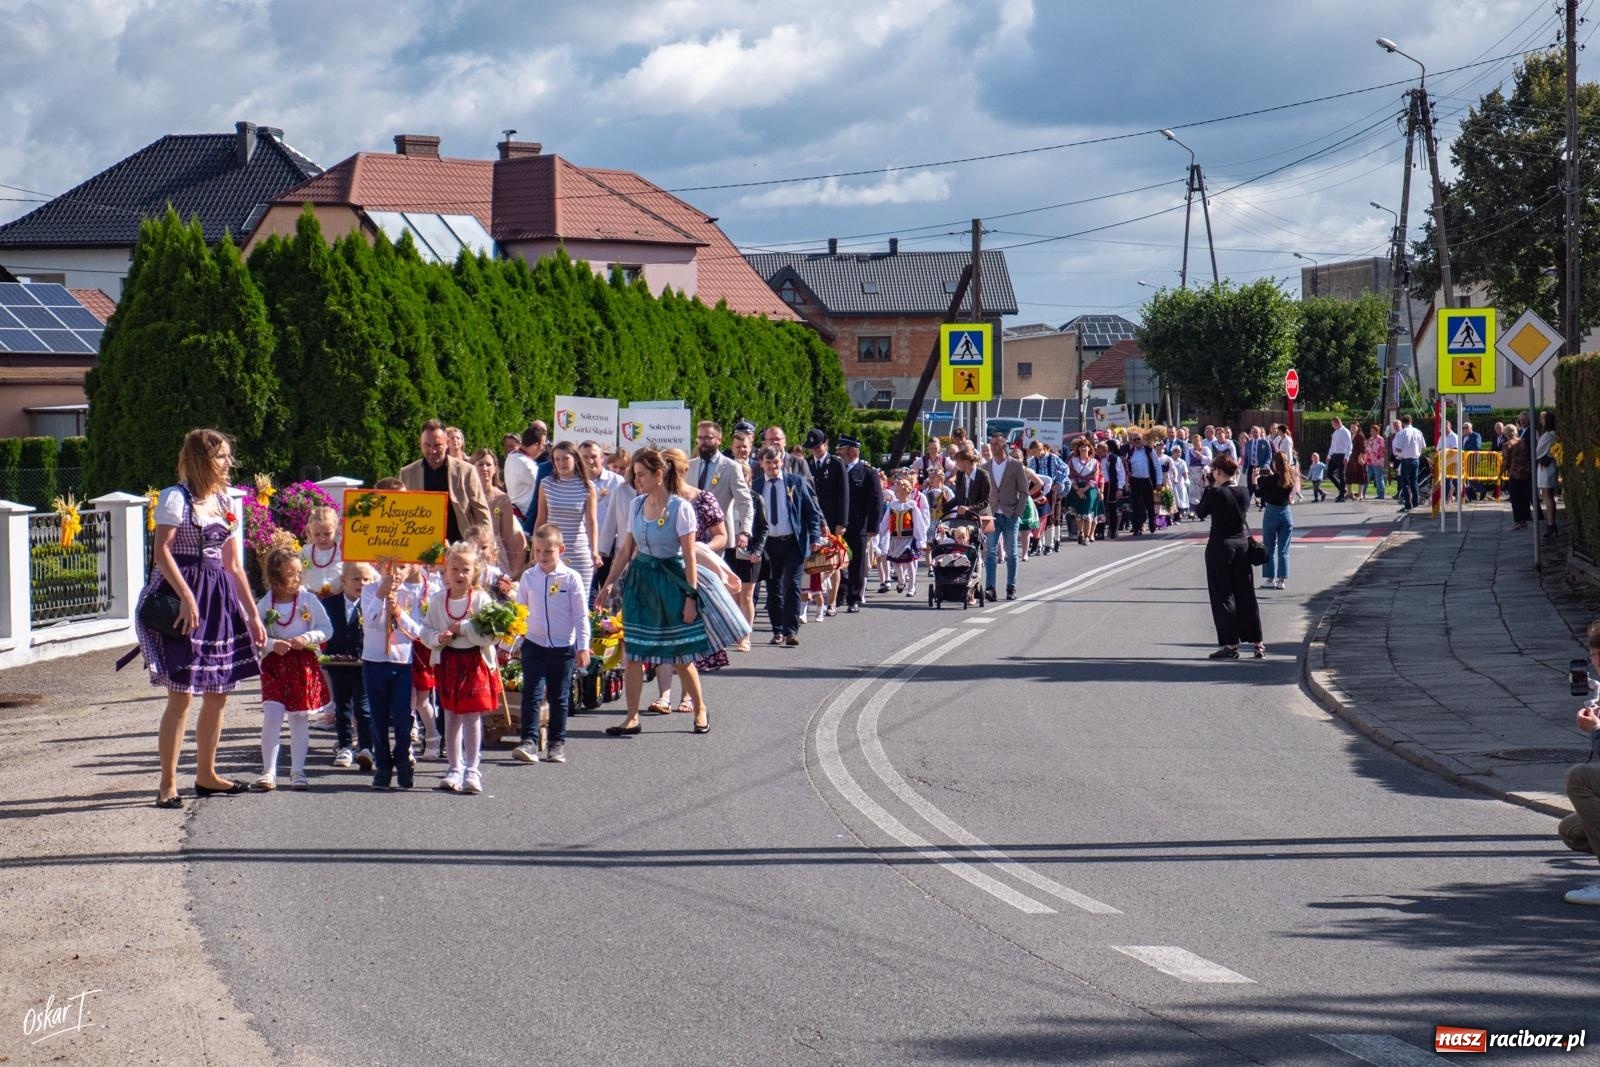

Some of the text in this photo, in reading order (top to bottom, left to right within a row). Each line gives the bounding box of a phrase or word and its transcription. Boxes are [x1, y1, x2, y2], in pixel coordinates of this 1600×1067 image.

[649, 423, 682, 432] Sołectwo
[380, 500, 432, 522] Wszystko
[351, 519, 435, 538] Cię mój Boże
